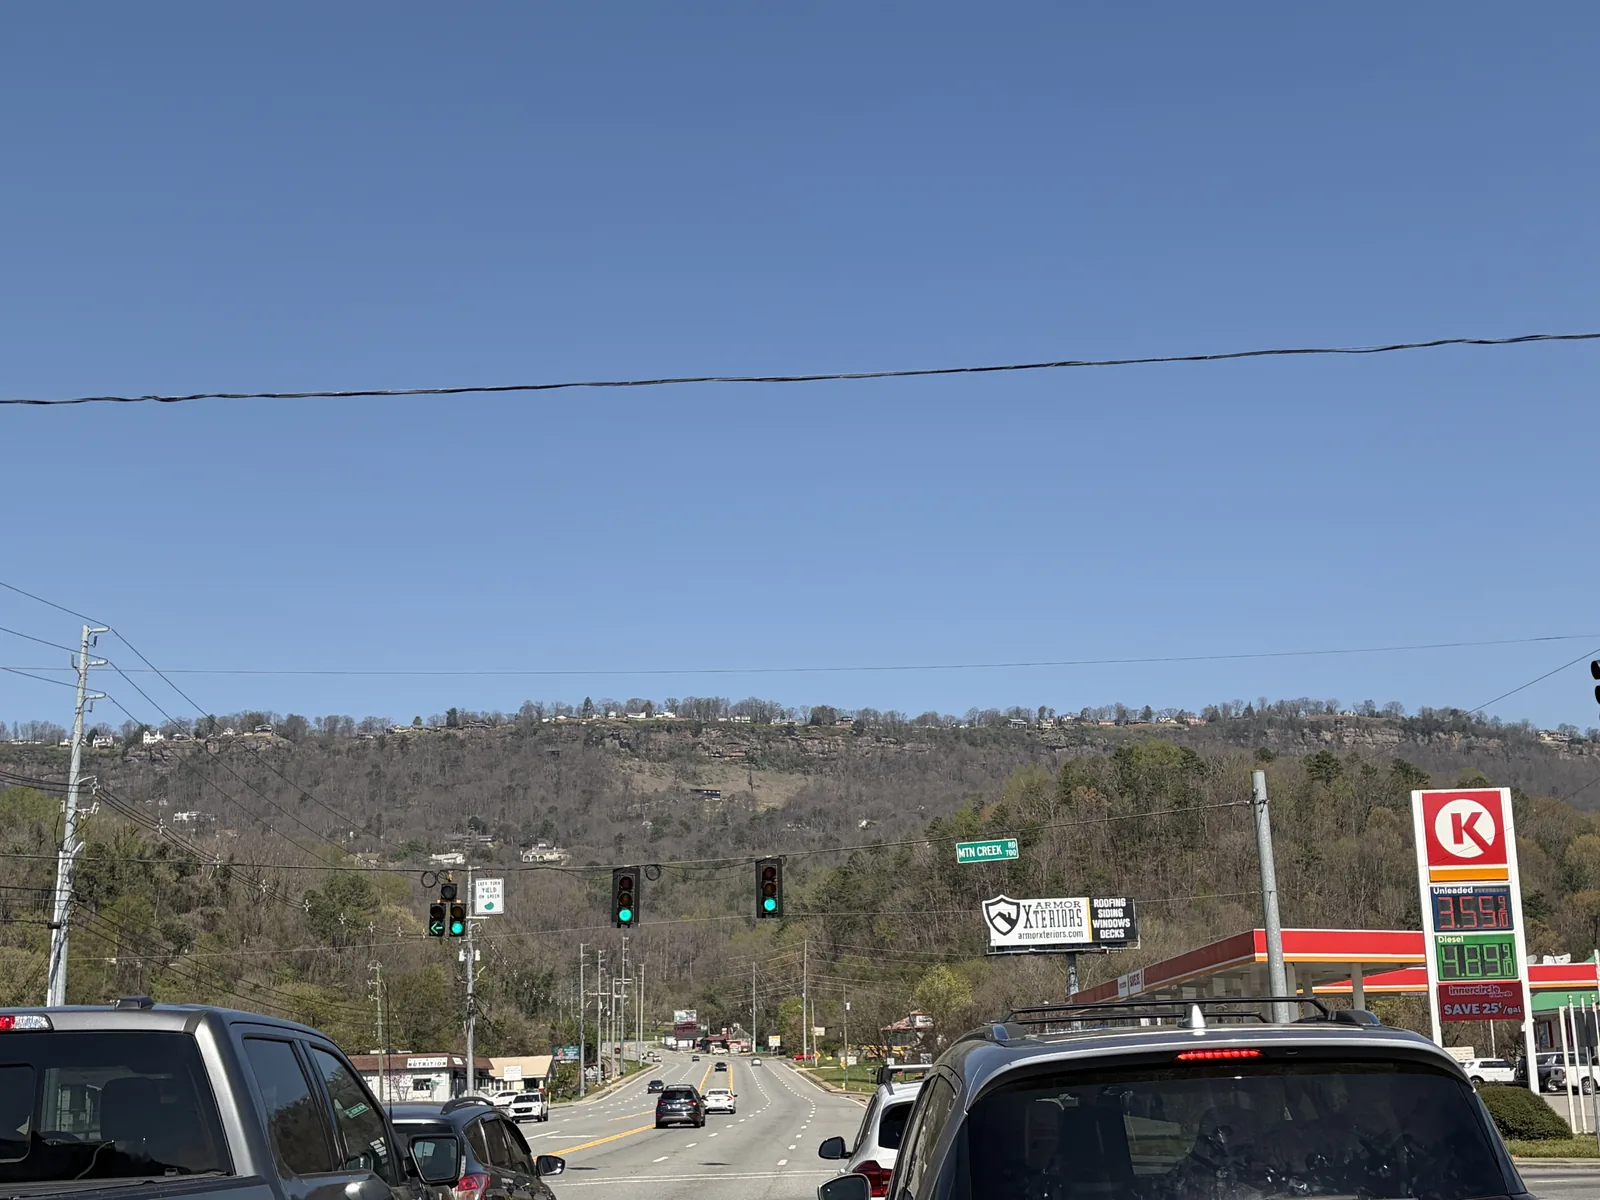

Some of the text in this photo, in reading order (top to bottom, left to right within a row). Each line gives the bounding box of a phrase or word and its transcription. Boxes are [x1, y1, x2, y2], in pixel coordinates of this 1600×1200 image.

[1007, 841, 1016, 849] RD
[958, 845, 1003, 858] MTN CREEK
[1005, 849, 1017, 857] 700
[1433, 886, 1474, 895] Unleaded
[1034, 900, 1082, 910] ARMOR
[1093, 897, 1127, 908] ROOFING
[1022, 905, 1083, 929] XTERIORS
[1097, 908, 1124, 918] SIDING
[1092, 918, 1131, 929] WINDOWS
[1017, 929, 1084, 940] armorxteriors.com
[1100, 928, 1125, 939] DECKS
[1437, 935, 1464, 943] Diesel
[1441, 944, 1502, 977] 4.89
[1449, 985, 1500, 995] innercircle
[1444, 1003, 1480, 1015] SAVE
